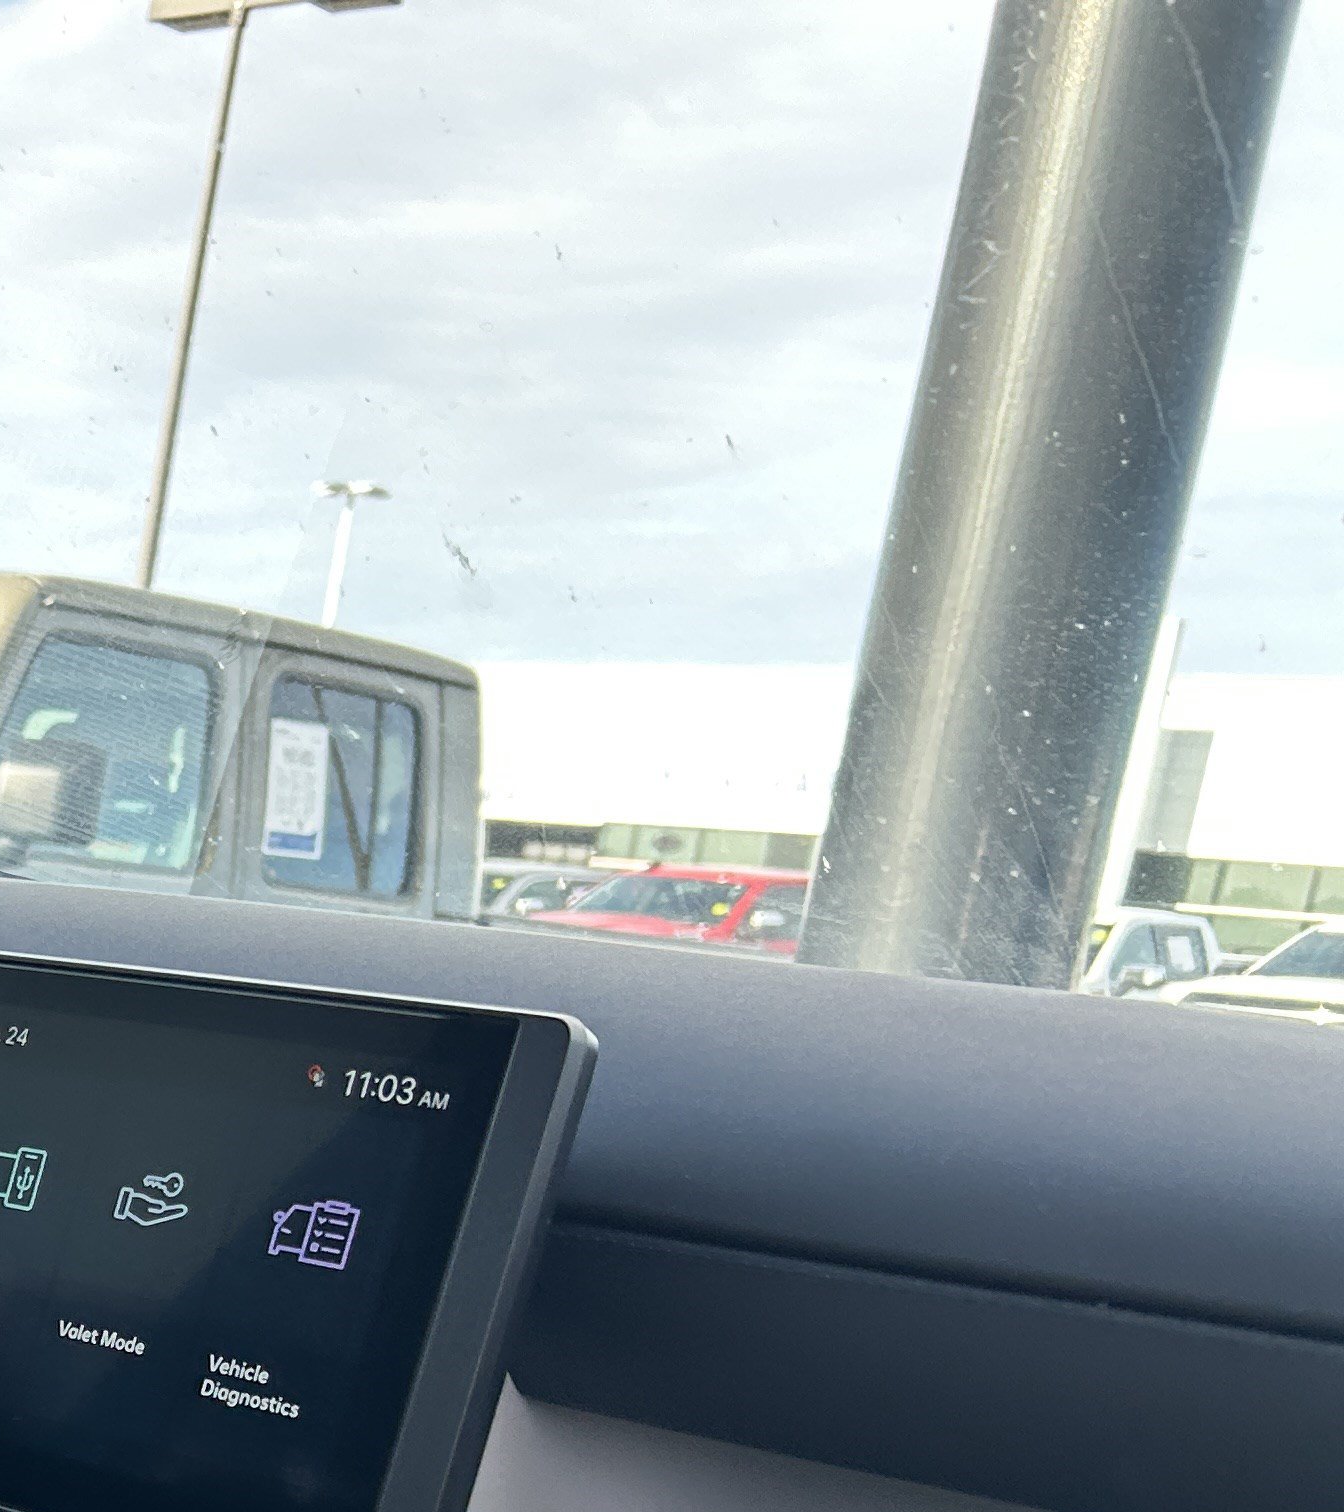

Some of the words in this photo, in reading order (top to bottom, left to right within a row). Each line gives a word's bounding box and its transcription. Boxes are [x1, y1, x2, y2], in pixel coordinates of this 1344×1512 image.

[5, 1026, 30, 1047] 24
[344, 1069, 418, 1106] 11:03
[417, 1090, 451, 1111] AM
[58, 1319, 100, 1346] Valet
[100, 1328, 146, 1356] Mode
[208, 1353, 270, 1385] Vehicle
[200, 1378, 301, 1419] Diagnostics
